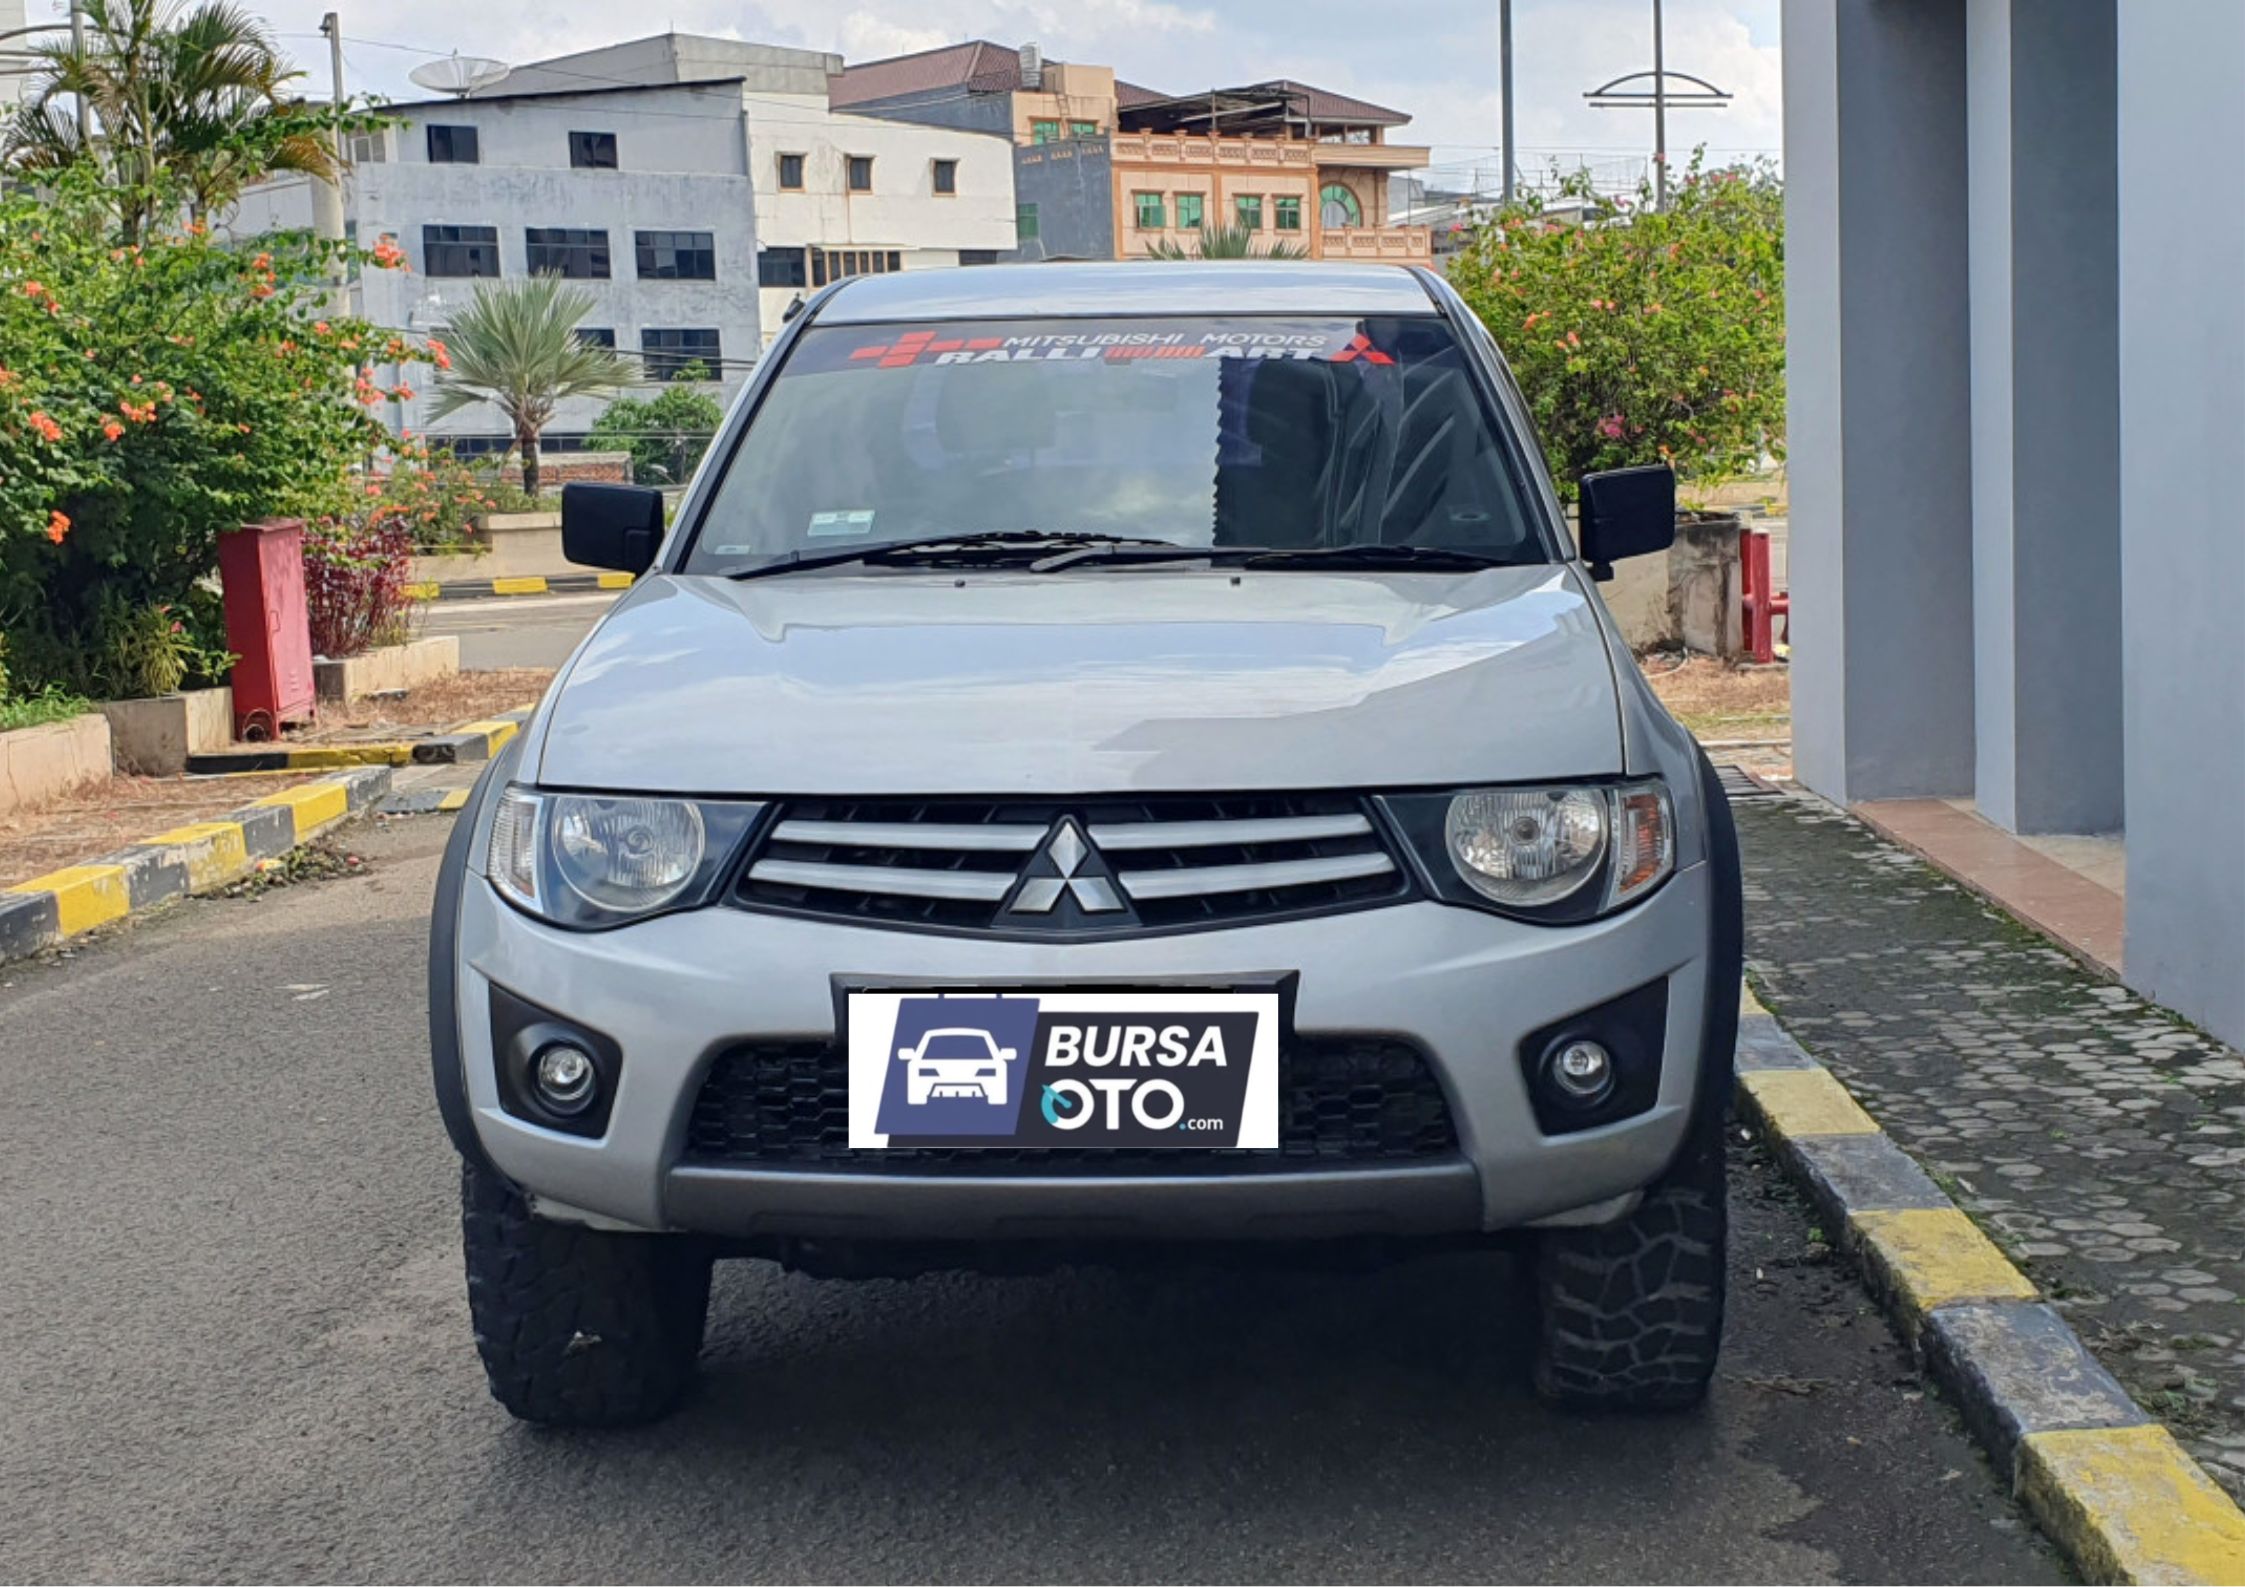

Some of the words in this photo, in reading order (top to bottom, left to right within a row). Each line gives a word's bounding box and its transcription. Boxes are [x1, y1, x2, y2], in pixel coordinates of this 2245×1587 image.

[1002, 332, 1185, 347] MITSUBISHI
[1199, 332, 1329, 347] MOTORS
[934, 346, 1103, 365] RALLI
[1202, 345, 1316, 360] ART
